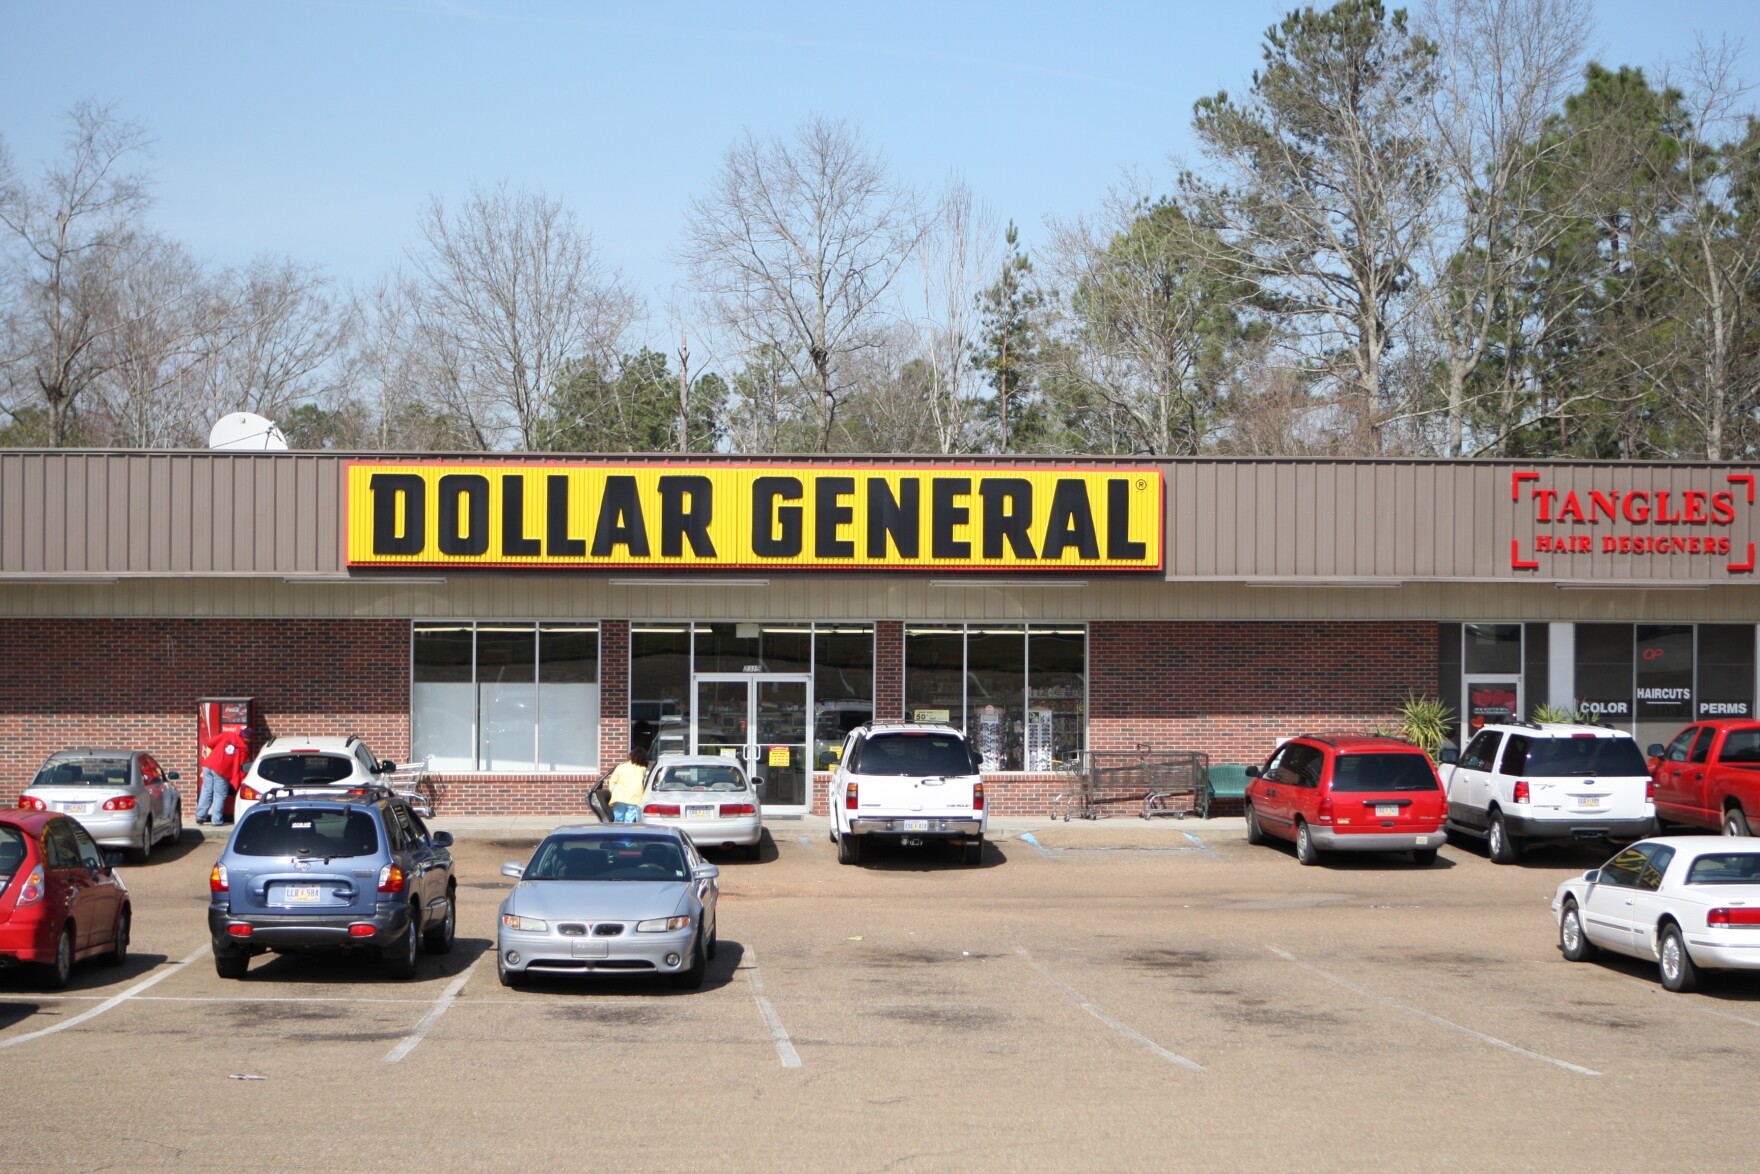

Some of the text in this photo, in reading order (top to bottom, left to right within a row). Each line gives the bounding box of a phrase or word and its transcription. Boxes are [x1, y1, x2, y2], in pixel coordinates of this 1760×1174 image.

[1532, 490, 1736, 524] TANGLES
[369, 474, 718, 558] DOLLAR
[751, 476, 1148, 560] GENERAL
[1535, 536, 1731, 554] HAIR DESIGNERS
[1636, 688, 1691, 699] HAIRCUTS
[1580, 702, 1628, 714] COLOR
[1700, 703, 1748, 714] PERMS
